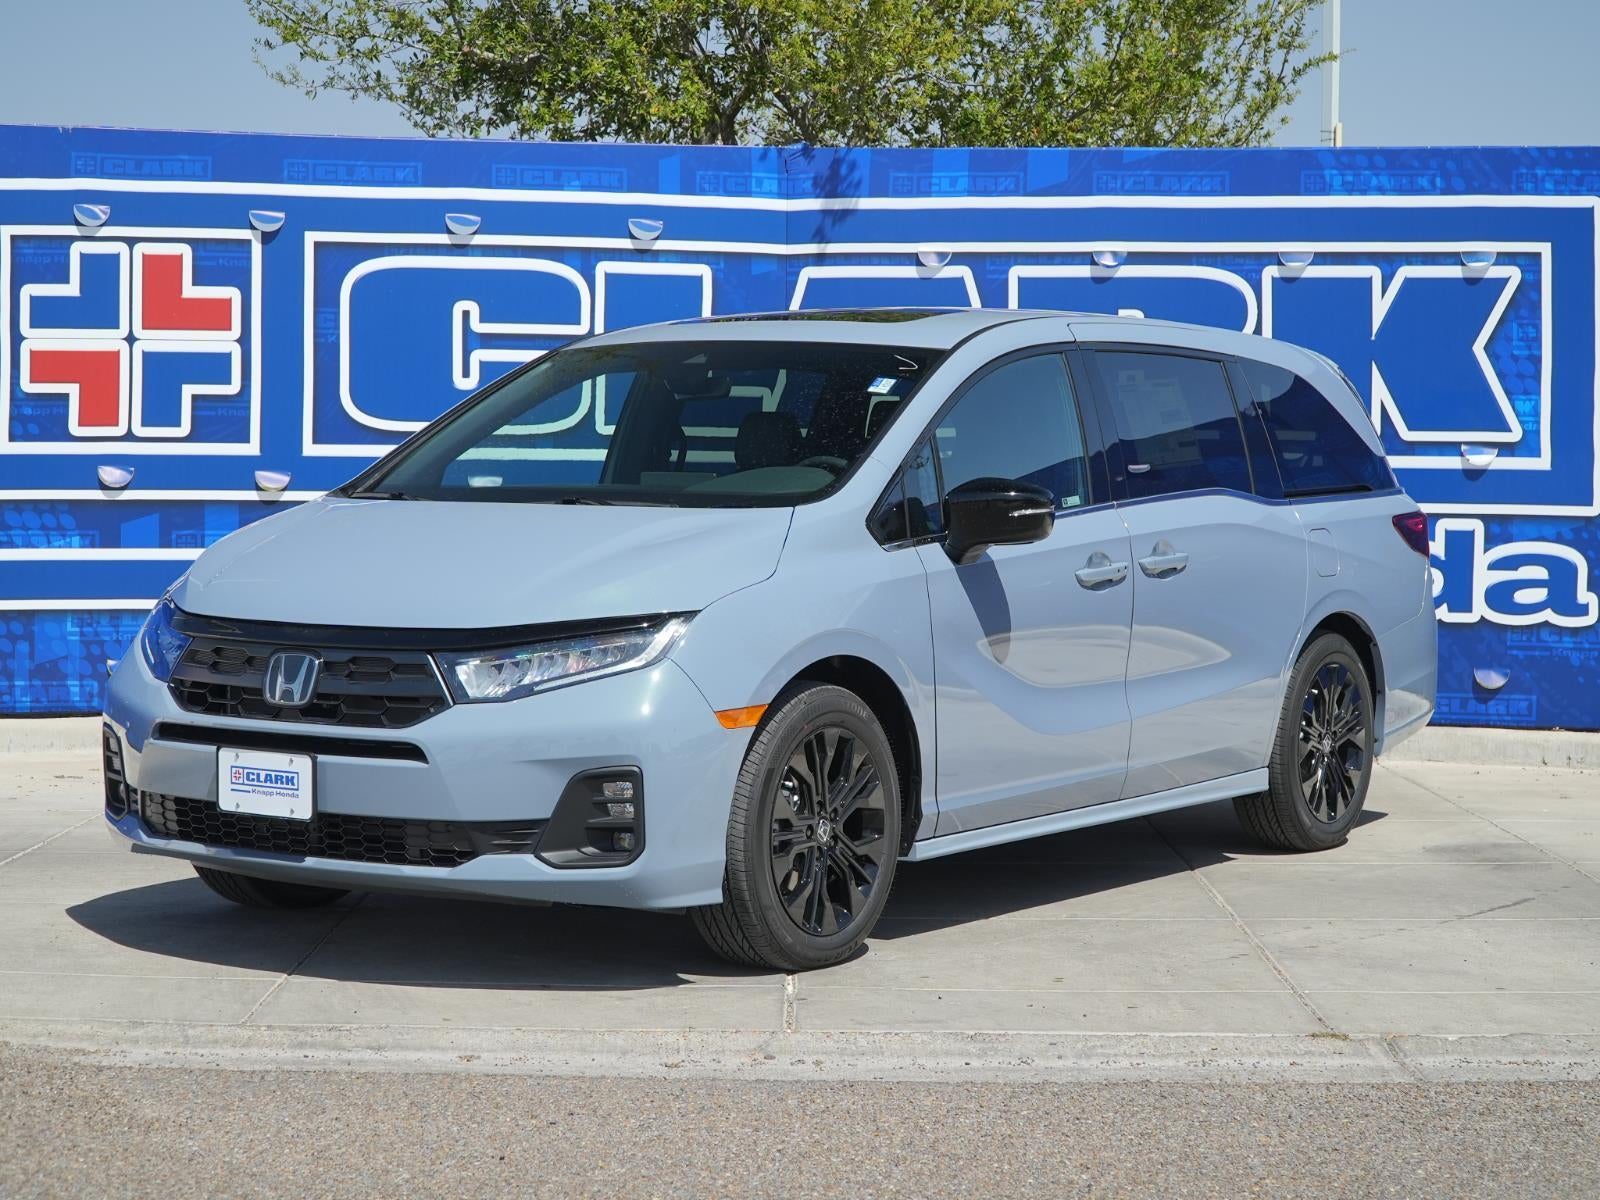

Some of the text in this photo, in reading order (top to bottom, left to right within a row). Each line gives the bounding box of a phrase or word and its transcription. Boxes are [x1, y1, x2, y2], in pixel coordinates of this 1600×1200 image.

[1543, 175, 1600, 192] CLA
[339, 254, 1522, 444] CLK
[245, 771, 296, 787] CLARK
[251, 788, 300, 799] Knapp Honda
